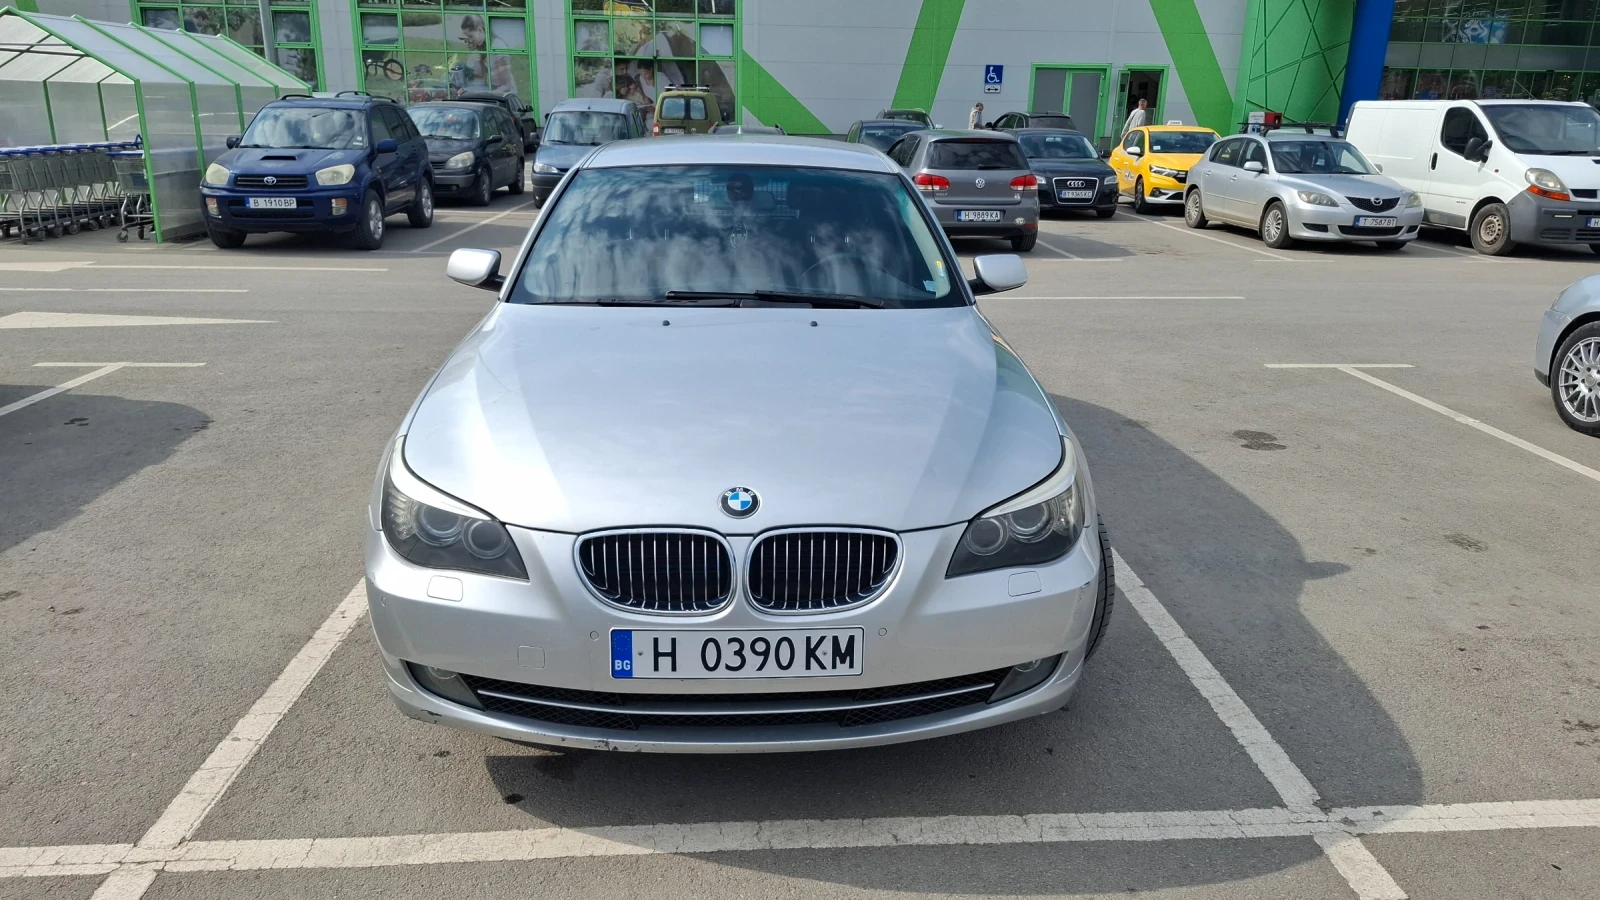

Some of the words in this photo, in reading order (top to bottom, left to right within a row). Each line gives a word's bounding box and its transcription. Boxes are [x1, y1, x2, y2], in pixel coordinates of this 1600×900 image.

[253, 199, 259, 207] B
[1363, 218, 1368, 226] T
[724, 487, 755, 497] BMW
[653, 637, 677, 672] H
[614, 660, 631, 671] BG
